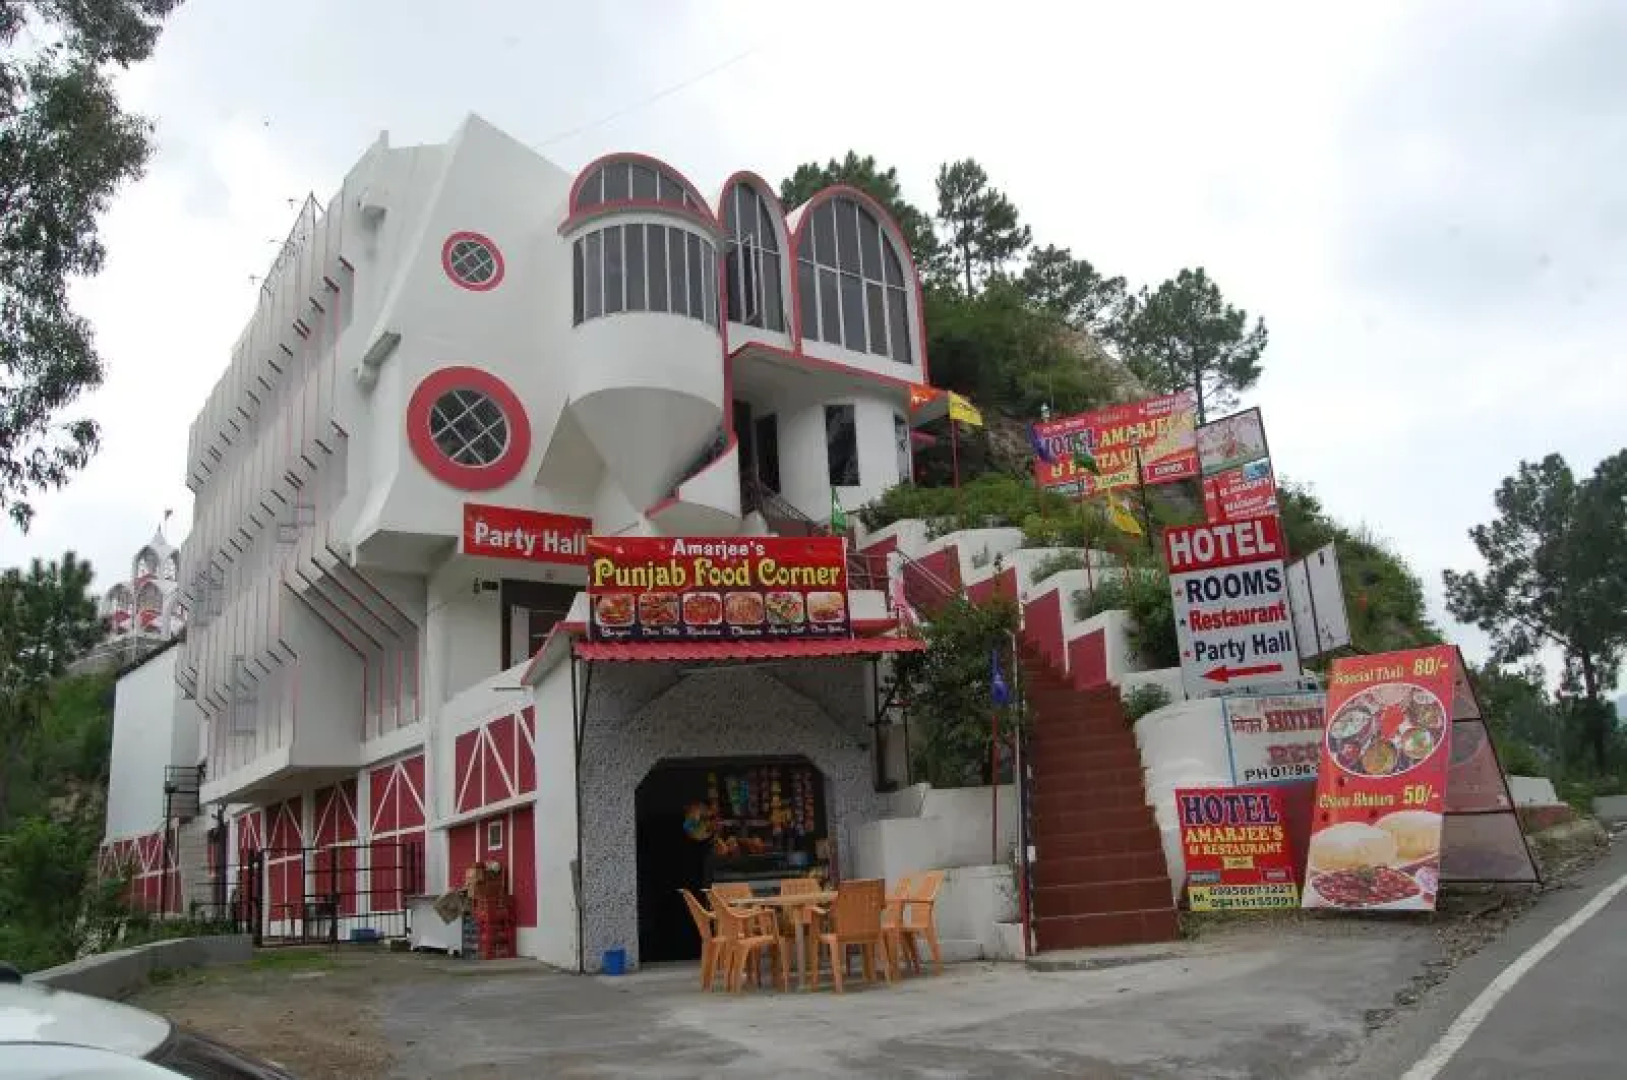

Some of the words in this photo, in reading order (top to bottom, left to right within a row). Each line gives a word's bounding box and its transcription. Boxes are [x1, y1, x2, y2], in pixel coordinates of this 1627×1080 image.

[474, 520, 536, 556] Party
[543, 530, 587, 556] Hall
[672, 538, 765, 561] Amarjee's
[1168, 520, 1276, 567] HOTEL
[594, 557, 687, 591] Punjab
[693, 557, 750, 587] Food
[757, 556, 841, 586] Corner
[1185, 566, 1282, 603] ROOMS
[1188, 599, 1287, 632] Restaurant
[1194, 638, 1246, 663] Party
[1252, 630, 1292, 656] Hall
[1180, 794, 1280, 826] HOTEL
[1185, 826, 1284, 843] AMARJEE'S
[1203, 841, 1282, 855] RESTAURANT
